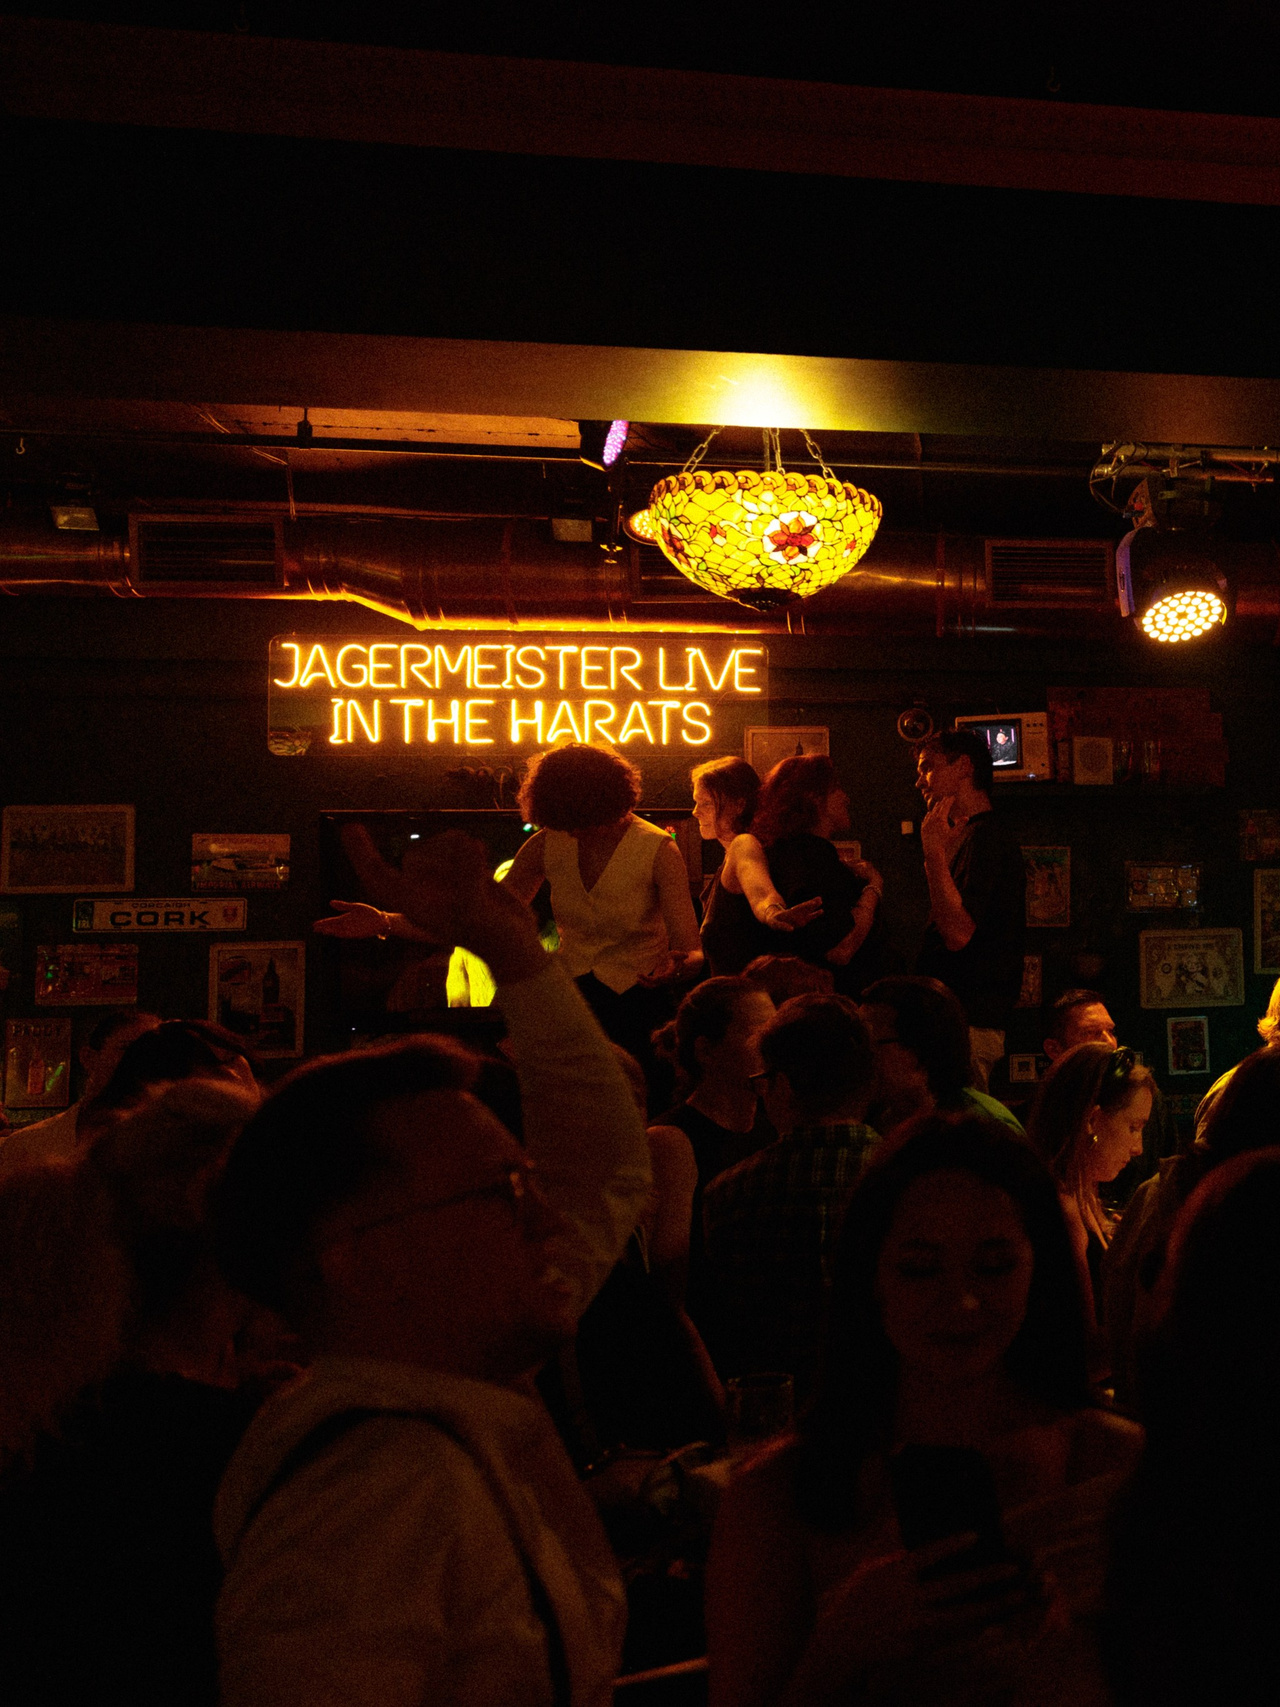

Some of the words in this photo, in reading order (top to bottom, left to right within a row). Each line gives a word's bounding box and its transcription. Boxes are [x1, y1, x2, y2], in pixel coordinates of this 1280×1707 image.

[273, 643, 644, 691] JAGERMEISTER
[657, 646, 763, 693] LIVE
[328, 698, 380, 744] IN
[390, 698, 495, 744] THE
[510, 698, 712, 745] HARATS
[109, 911, 210, 926] CORK
